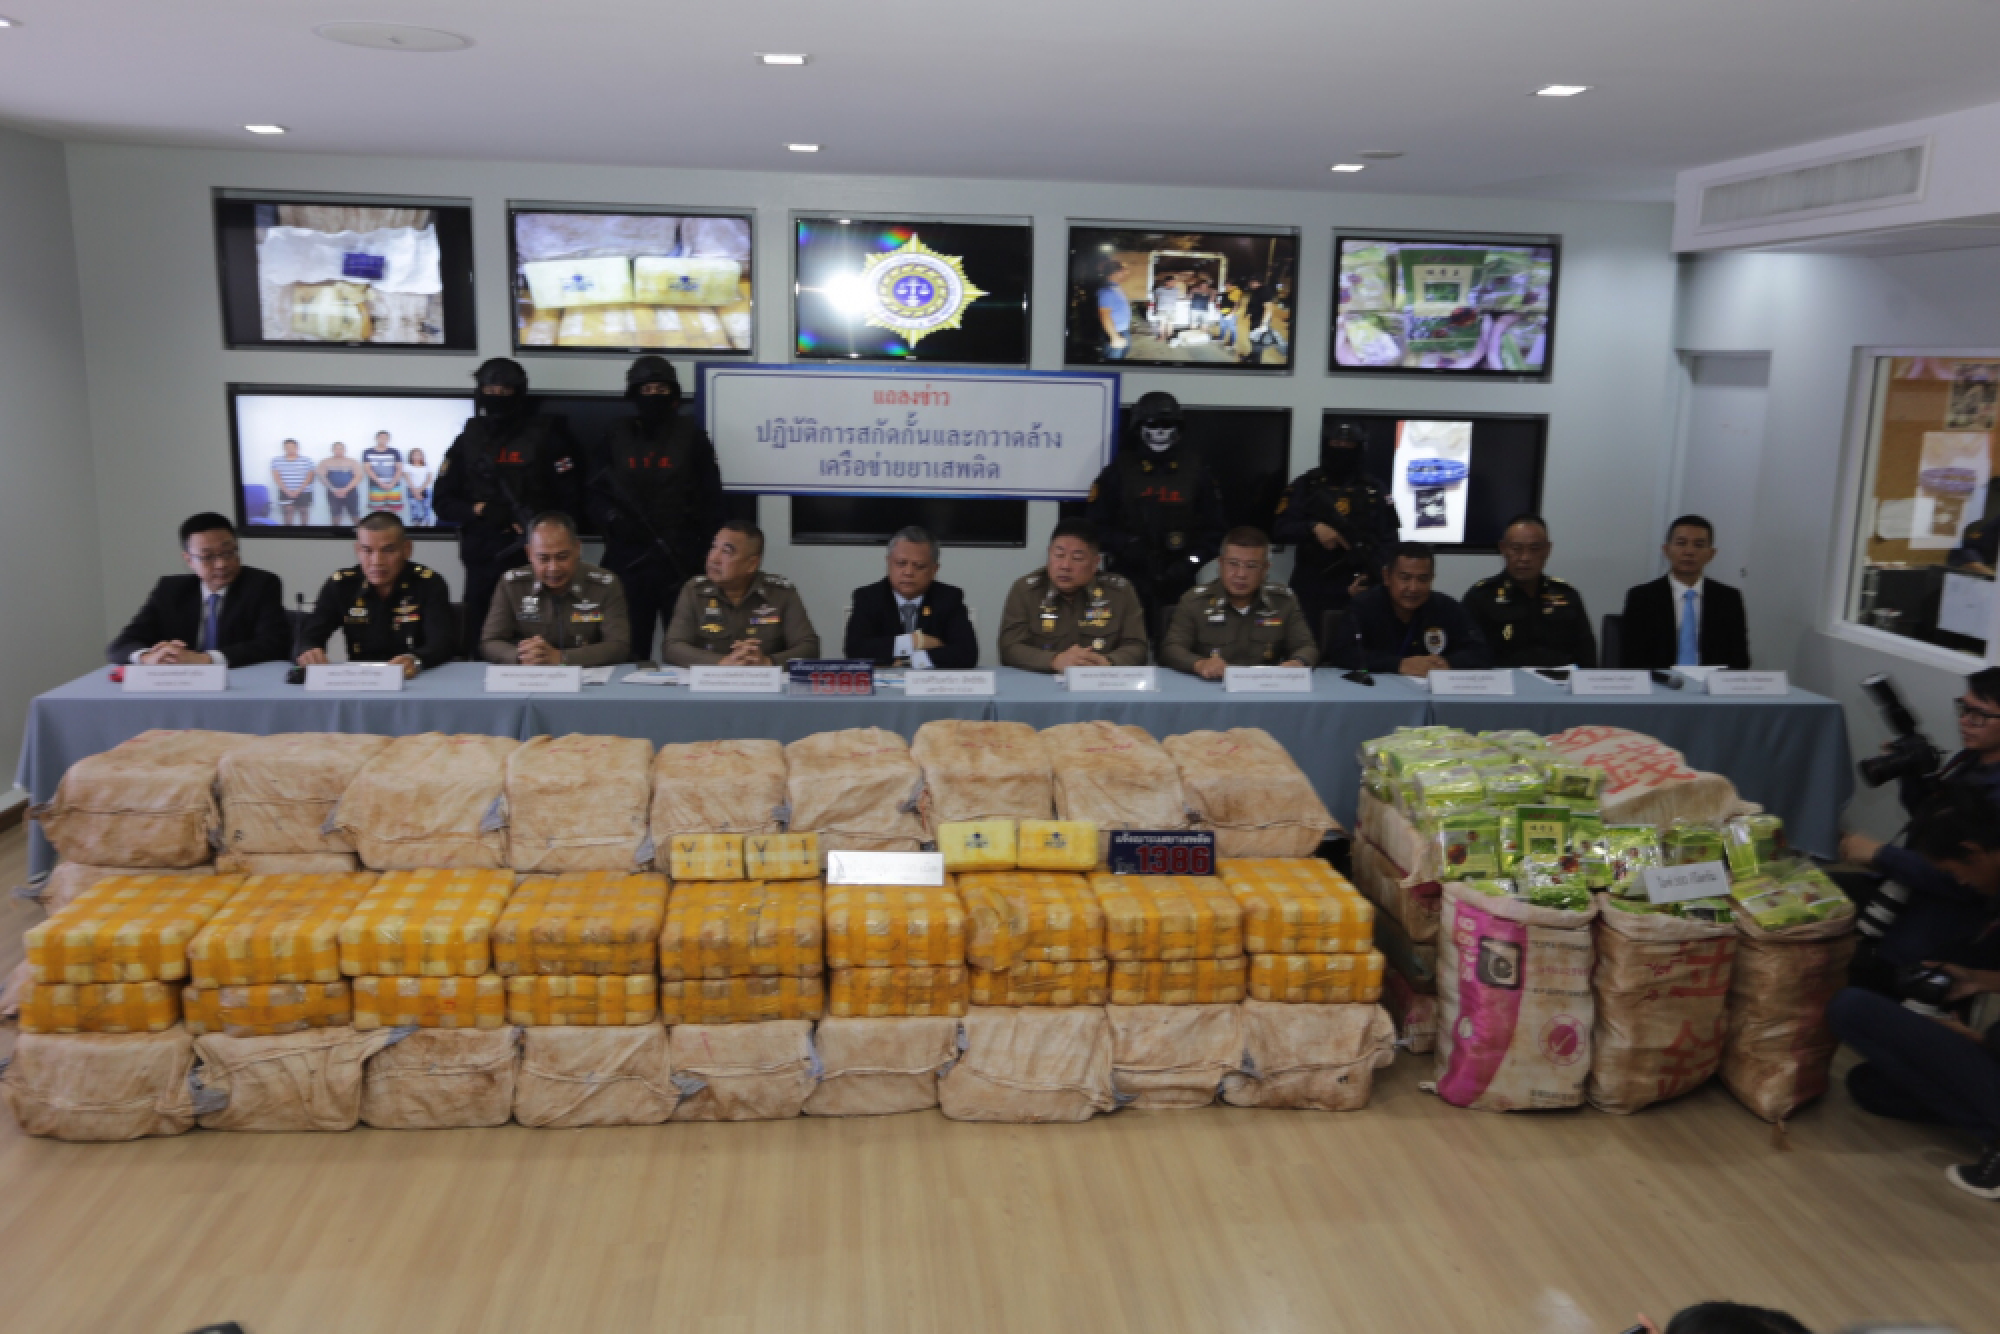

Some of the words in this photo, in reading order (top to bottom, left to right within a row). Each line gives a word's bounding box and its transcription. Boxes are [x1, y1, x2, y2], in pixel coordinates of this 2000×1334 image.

[873, 384, 950, 406] แถลงข่าว
[756, 411, 1063, 449] ปฏิบัติการสกัดกั้นและกวาดล้าง
[819, 450, 1001, 479] เครือข่ายยาเสพติด
[808, 672, 872, 695] 1386
[1136, 846, 1210, 873] 1386
